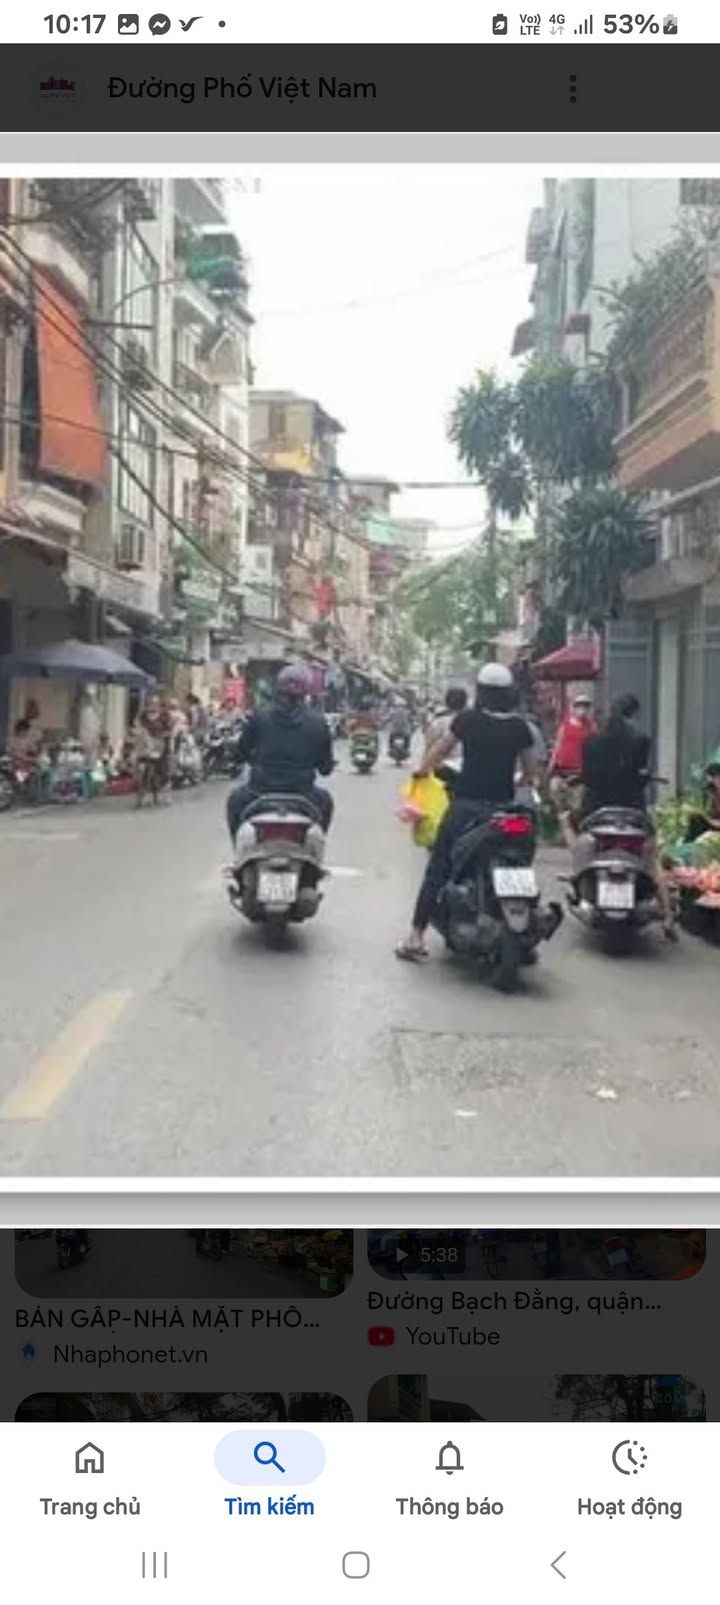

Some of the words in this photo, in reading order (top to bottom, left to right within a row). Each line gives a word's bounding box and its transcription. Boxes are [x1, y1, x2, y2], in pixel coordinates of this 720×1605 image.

[44, 14, 106, 34] 10:17
[520, 25, 540, 35] LTE
[549, 14, 565, 25] 4G
[604, 14, 659, 35] 53%
[108, 76, 195, 104] Đường
[204, 73, 252, 98] Phố
[259, 77, 310, 103] Việt
[319, 77, 376, 98] Nam
[422, 1247, 458, 1262] 5:38
[367, 1291, 443, 1315] Đường
[452, 1291, 506, 1315] Bạch
[513, 1288, 579, 1316] Đằng,
[16, 1305, 62, 1328] BÁN
[193, 1305, 243, 1333] MẶT
[406, 1327, 500, 1345] YouTube
[54, 1344, 207, 1368] Nhaphonet.vn
[40, 1497, 97, 1519] Trang
[103, 1497, 140, 1516] chủ
[224, 1497, 260, 1516] Tìm
[268, 1494, 314, 1516] kiếm
[396, 1497, 459, 1519] Thông
[467, 1497, 503, 1516] báo
[578, 1497, 625, 1519] Hoạt
[631, 1497, 682, 1519] động
